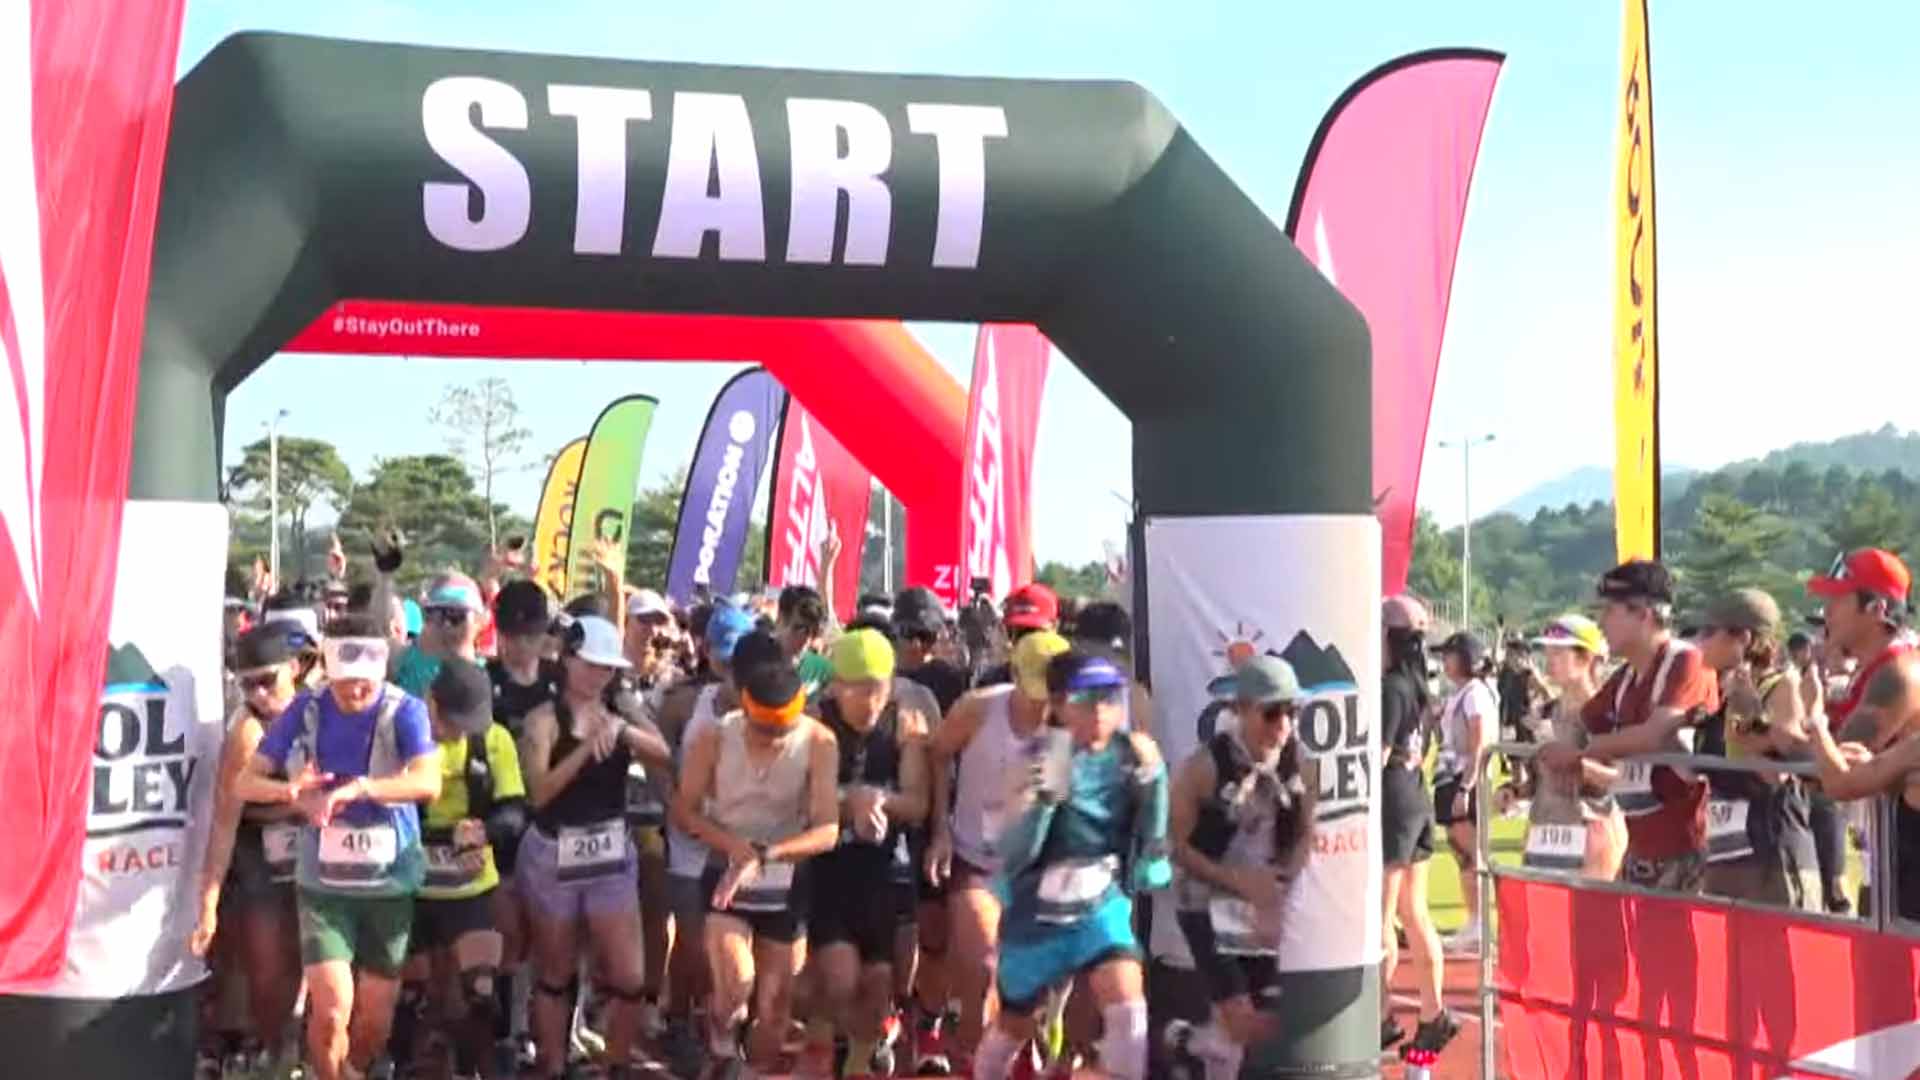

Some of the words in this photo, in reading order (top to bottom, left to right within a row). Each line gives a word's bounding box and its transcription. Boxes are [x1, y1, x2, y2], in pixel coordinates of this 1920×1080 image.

[421, 76, 1009, 269] START
[332, 315, 481, 340] #StayOutThere
[93, 698, 185, 761] OL
[92, 757, 197, 815] LEY
[573, 835, 612, 857] 204
